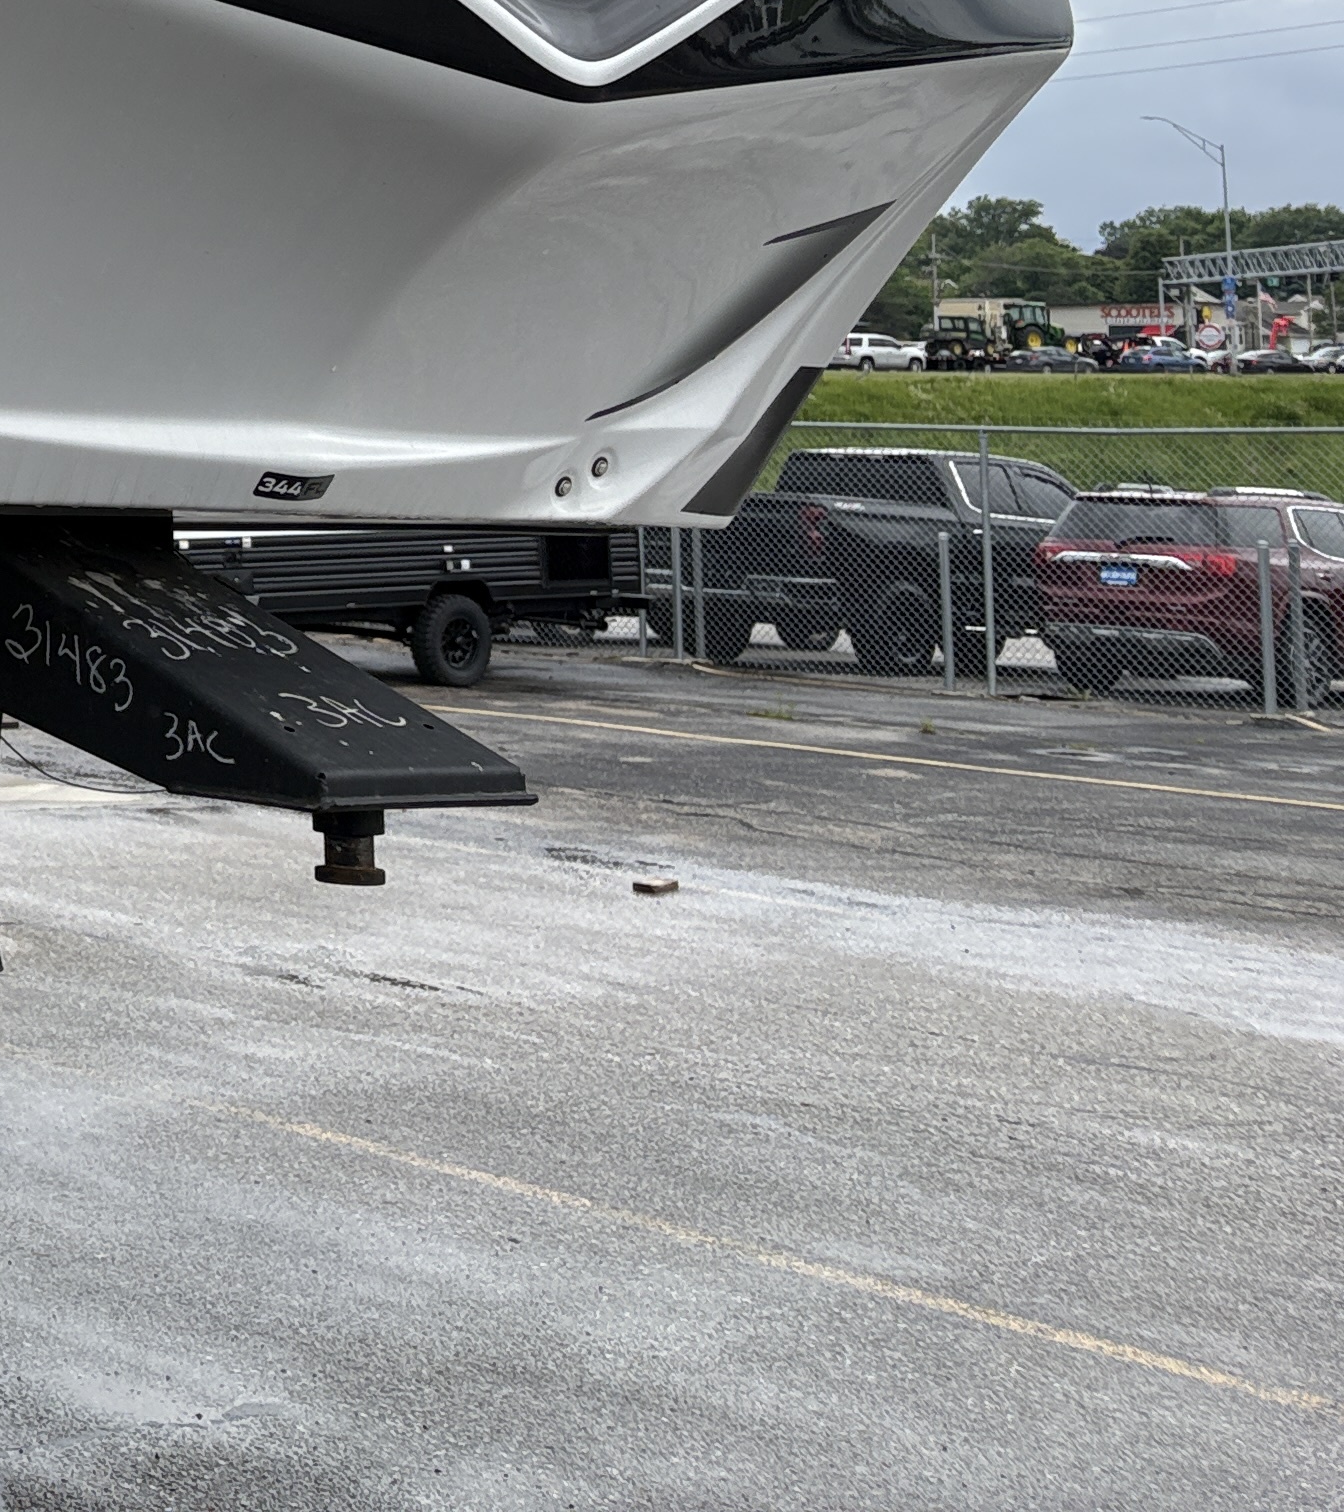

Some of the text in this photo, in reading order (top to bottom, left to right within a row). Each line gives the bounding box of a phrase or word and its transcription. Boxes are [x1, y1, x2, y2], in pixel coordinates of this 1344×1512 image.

[257, 477, 325, 496] 344FL
[4, 604, 134, 712] 31483
[163, 711, 236, 765] 3AC
